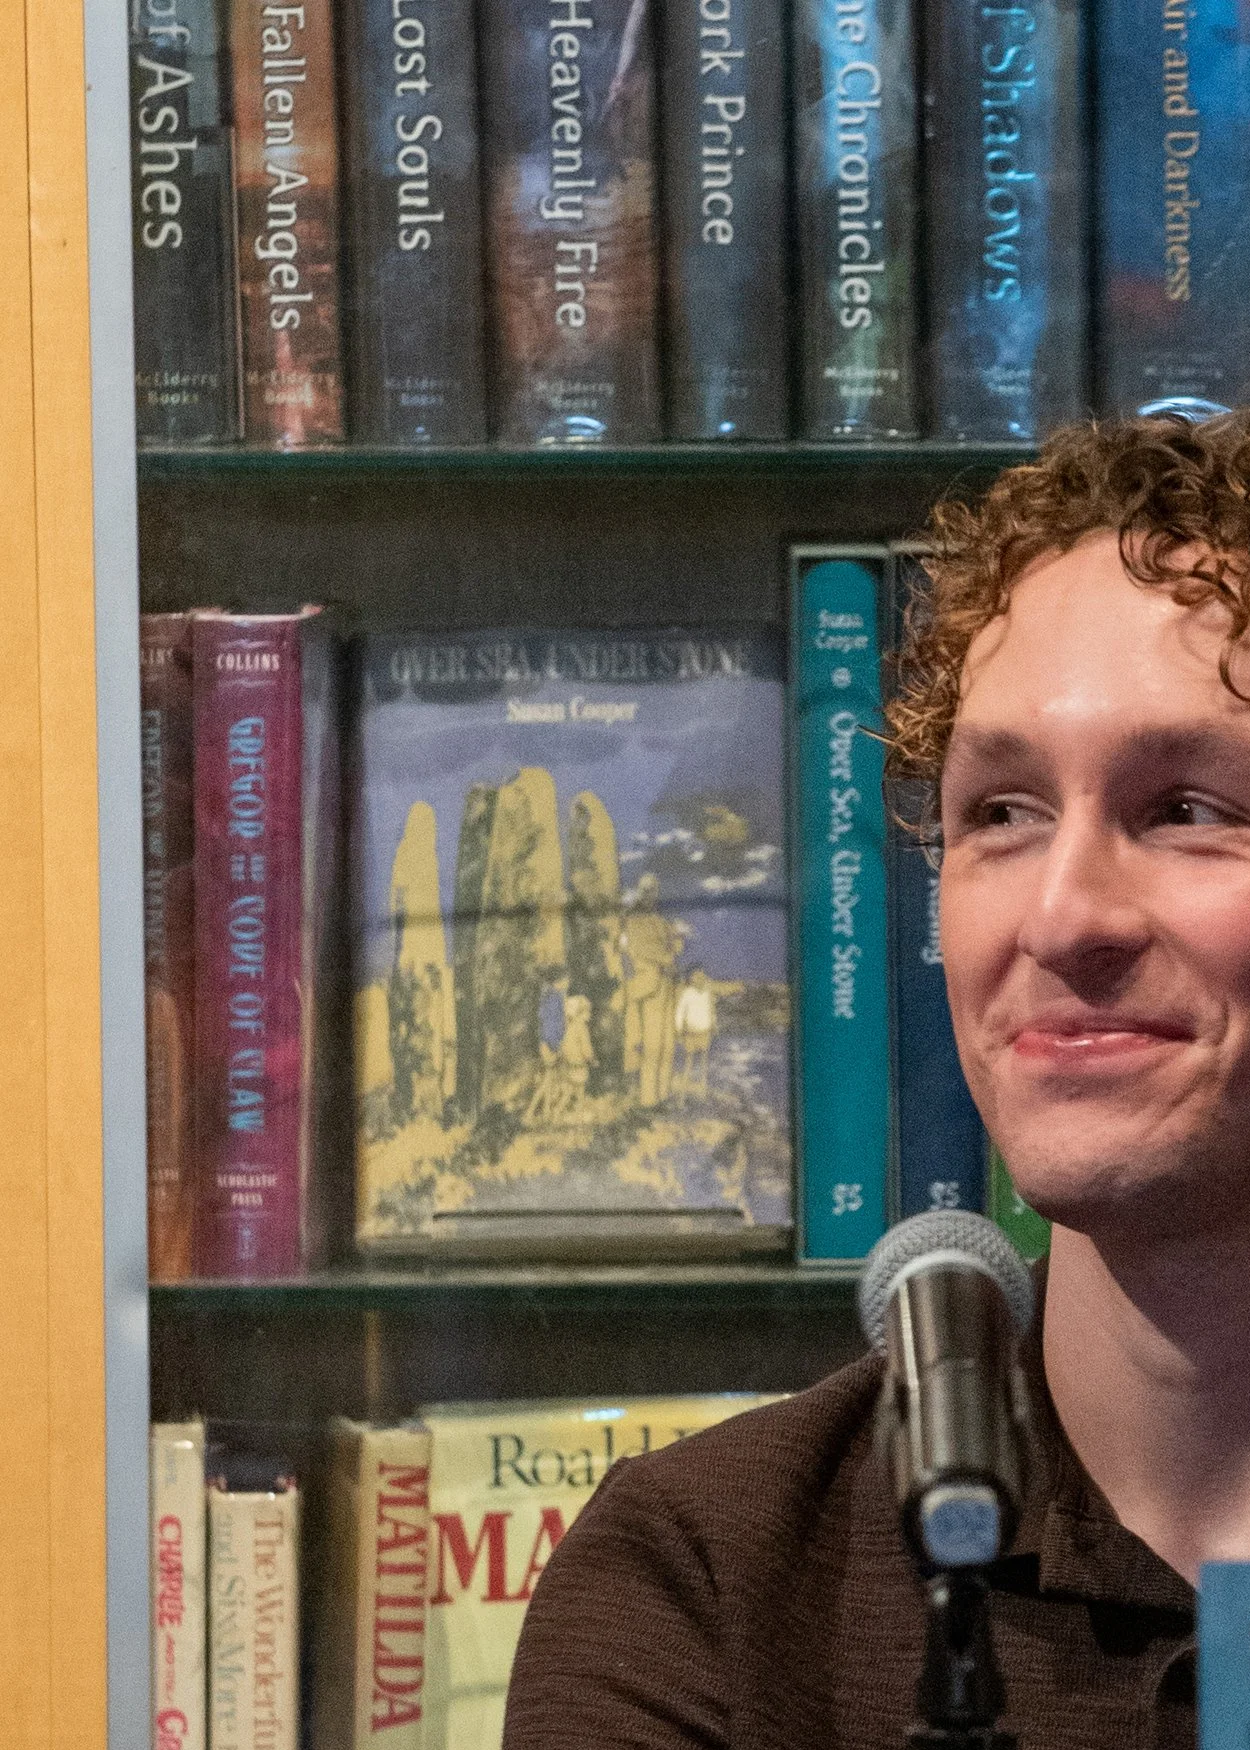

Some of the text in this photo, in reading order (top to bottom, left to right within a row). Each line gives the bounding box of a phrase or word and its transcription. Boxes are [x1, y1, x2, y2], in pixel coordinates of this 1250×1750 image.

[1162, 47, 1200, 118] and
[137, 53, 198, 249] Ashes
[255, 4, 313, 331] Fallen Angels
[397, 115, 445, 252] Souls
[540, 0, 600, 329] Heavenly Fire
[701, 96, 746, 246] Prince
[836, 61, 886, 330] Chronicles
[981, 46, 1037, 302] Shadows
[1162, 131, 1201, 301] Darkness
[215, 652, 282, 673] COLLINS
[505, 695, 641, 726] Susan Cooper
[227, 715, 267, 839] GREGOR
[827, 710, 859, 773] Over
[829, 850, 862, 934] Under
[227, 992, 267, 1034] OF
[831, 942, 864, 1021] Stone
[253, 1510, 285, 1581] The
[370, 1459, 431, 1733] MATILDA
